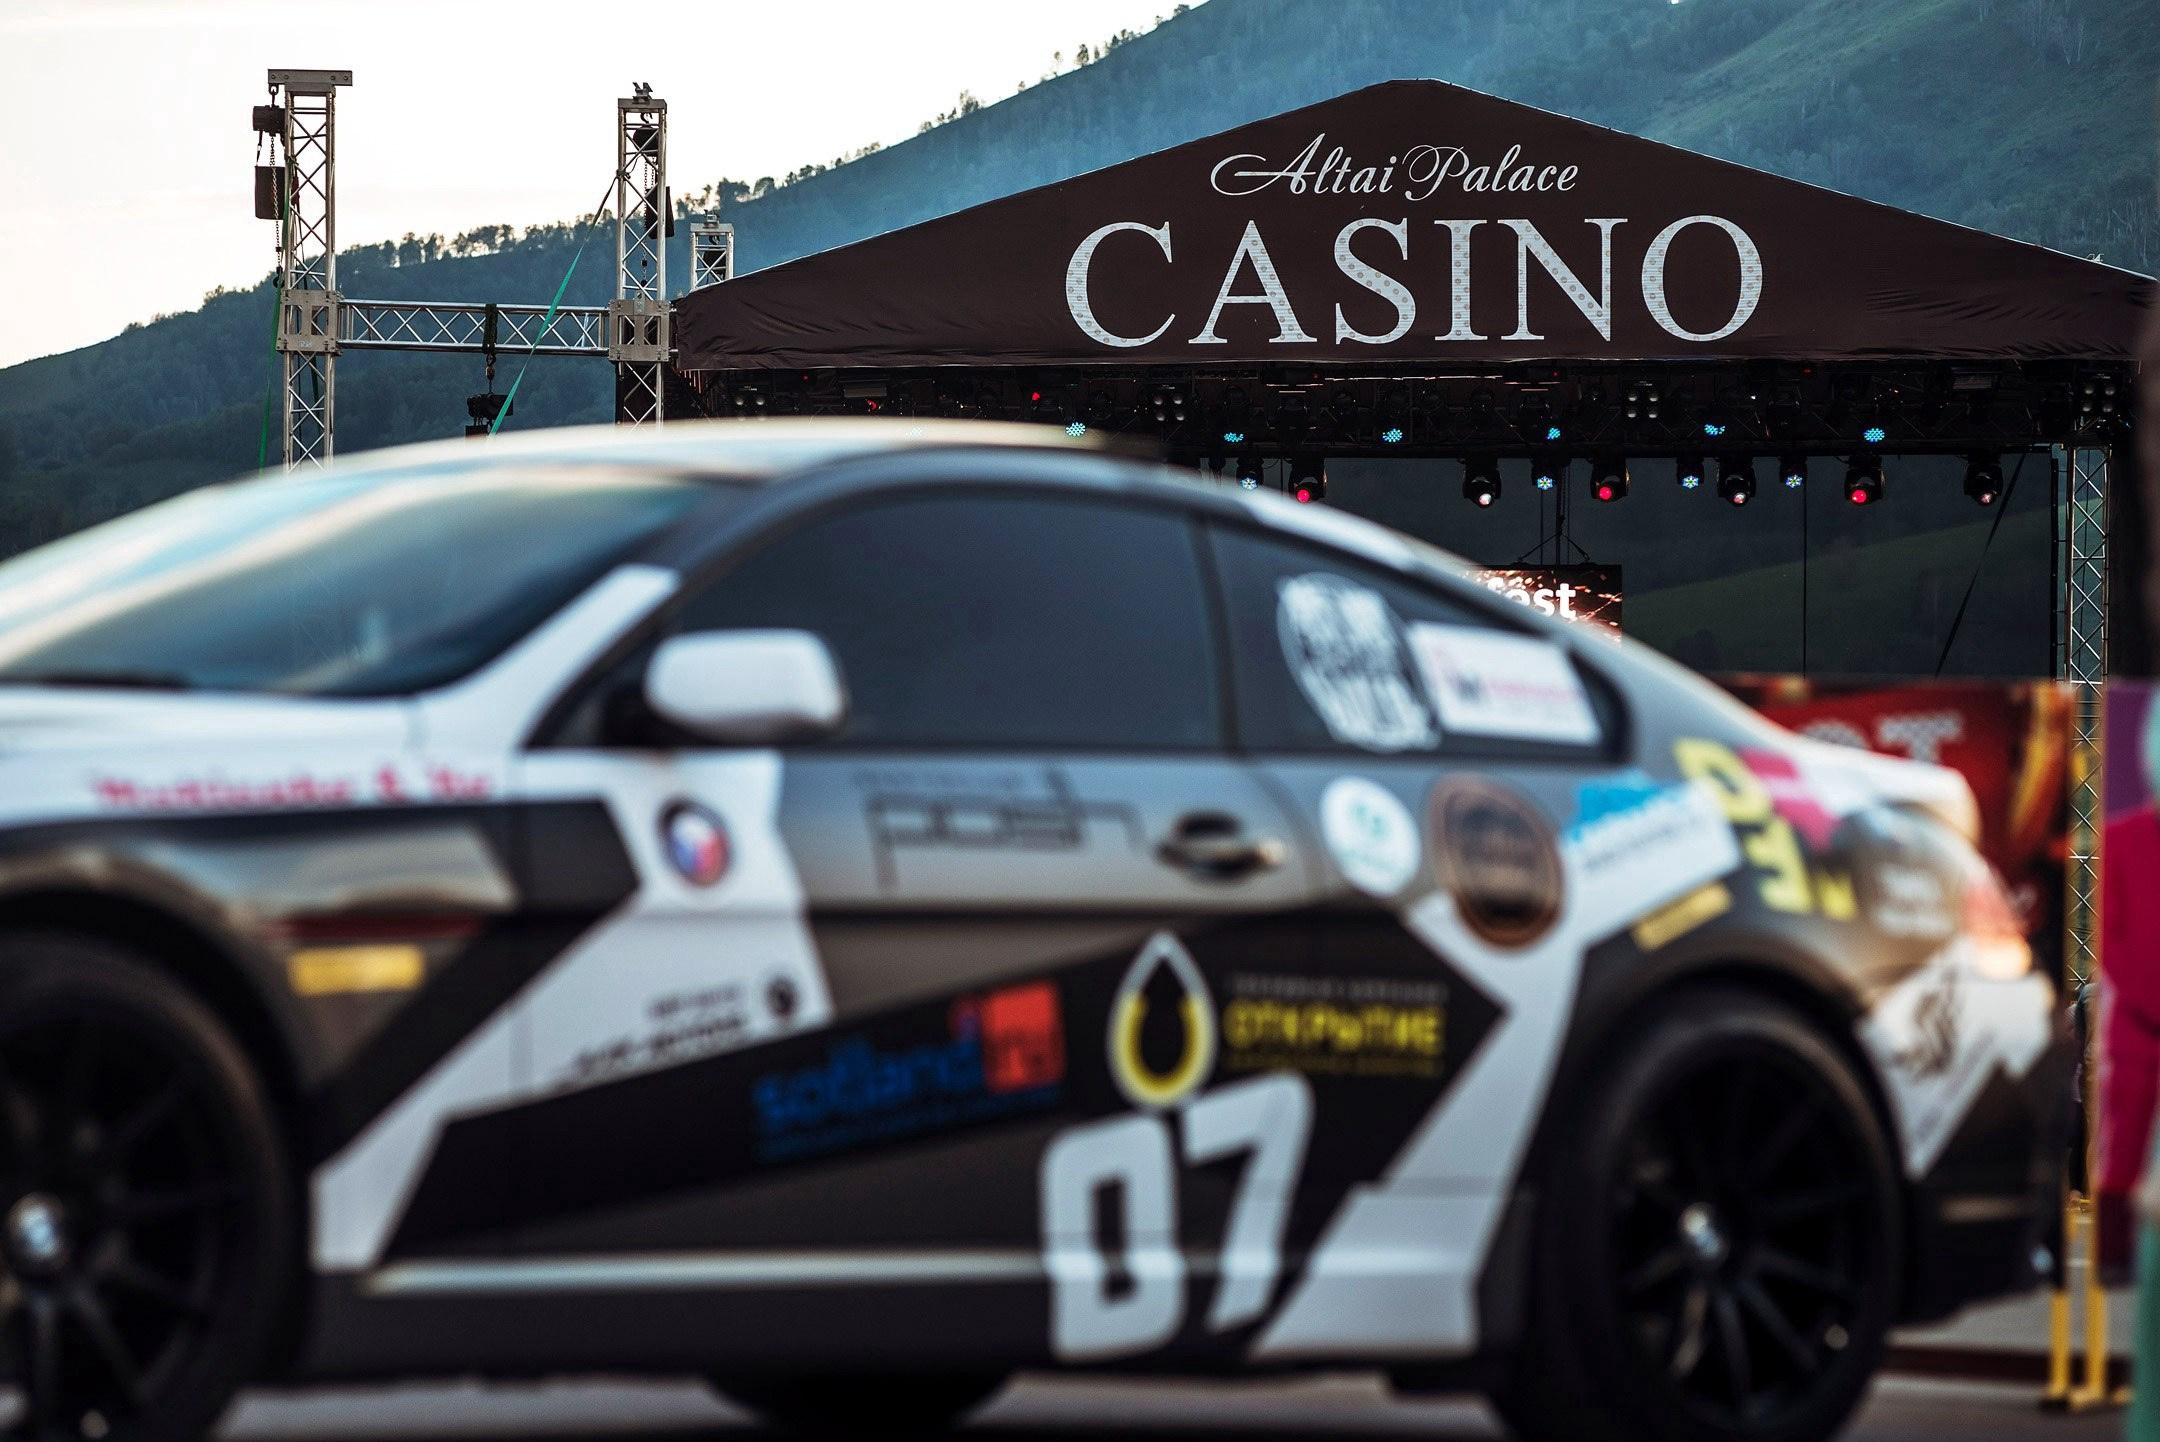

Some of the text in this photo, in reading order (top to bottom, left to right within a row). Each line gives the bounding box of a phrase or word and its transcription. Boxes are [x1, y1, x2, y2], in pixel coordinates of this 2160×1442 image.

[1210, 132, 1579, 201] Altai Palace
[1065, 215, 1763, 348] CASINO
[1041, 1074, 1313, 1360] 07
